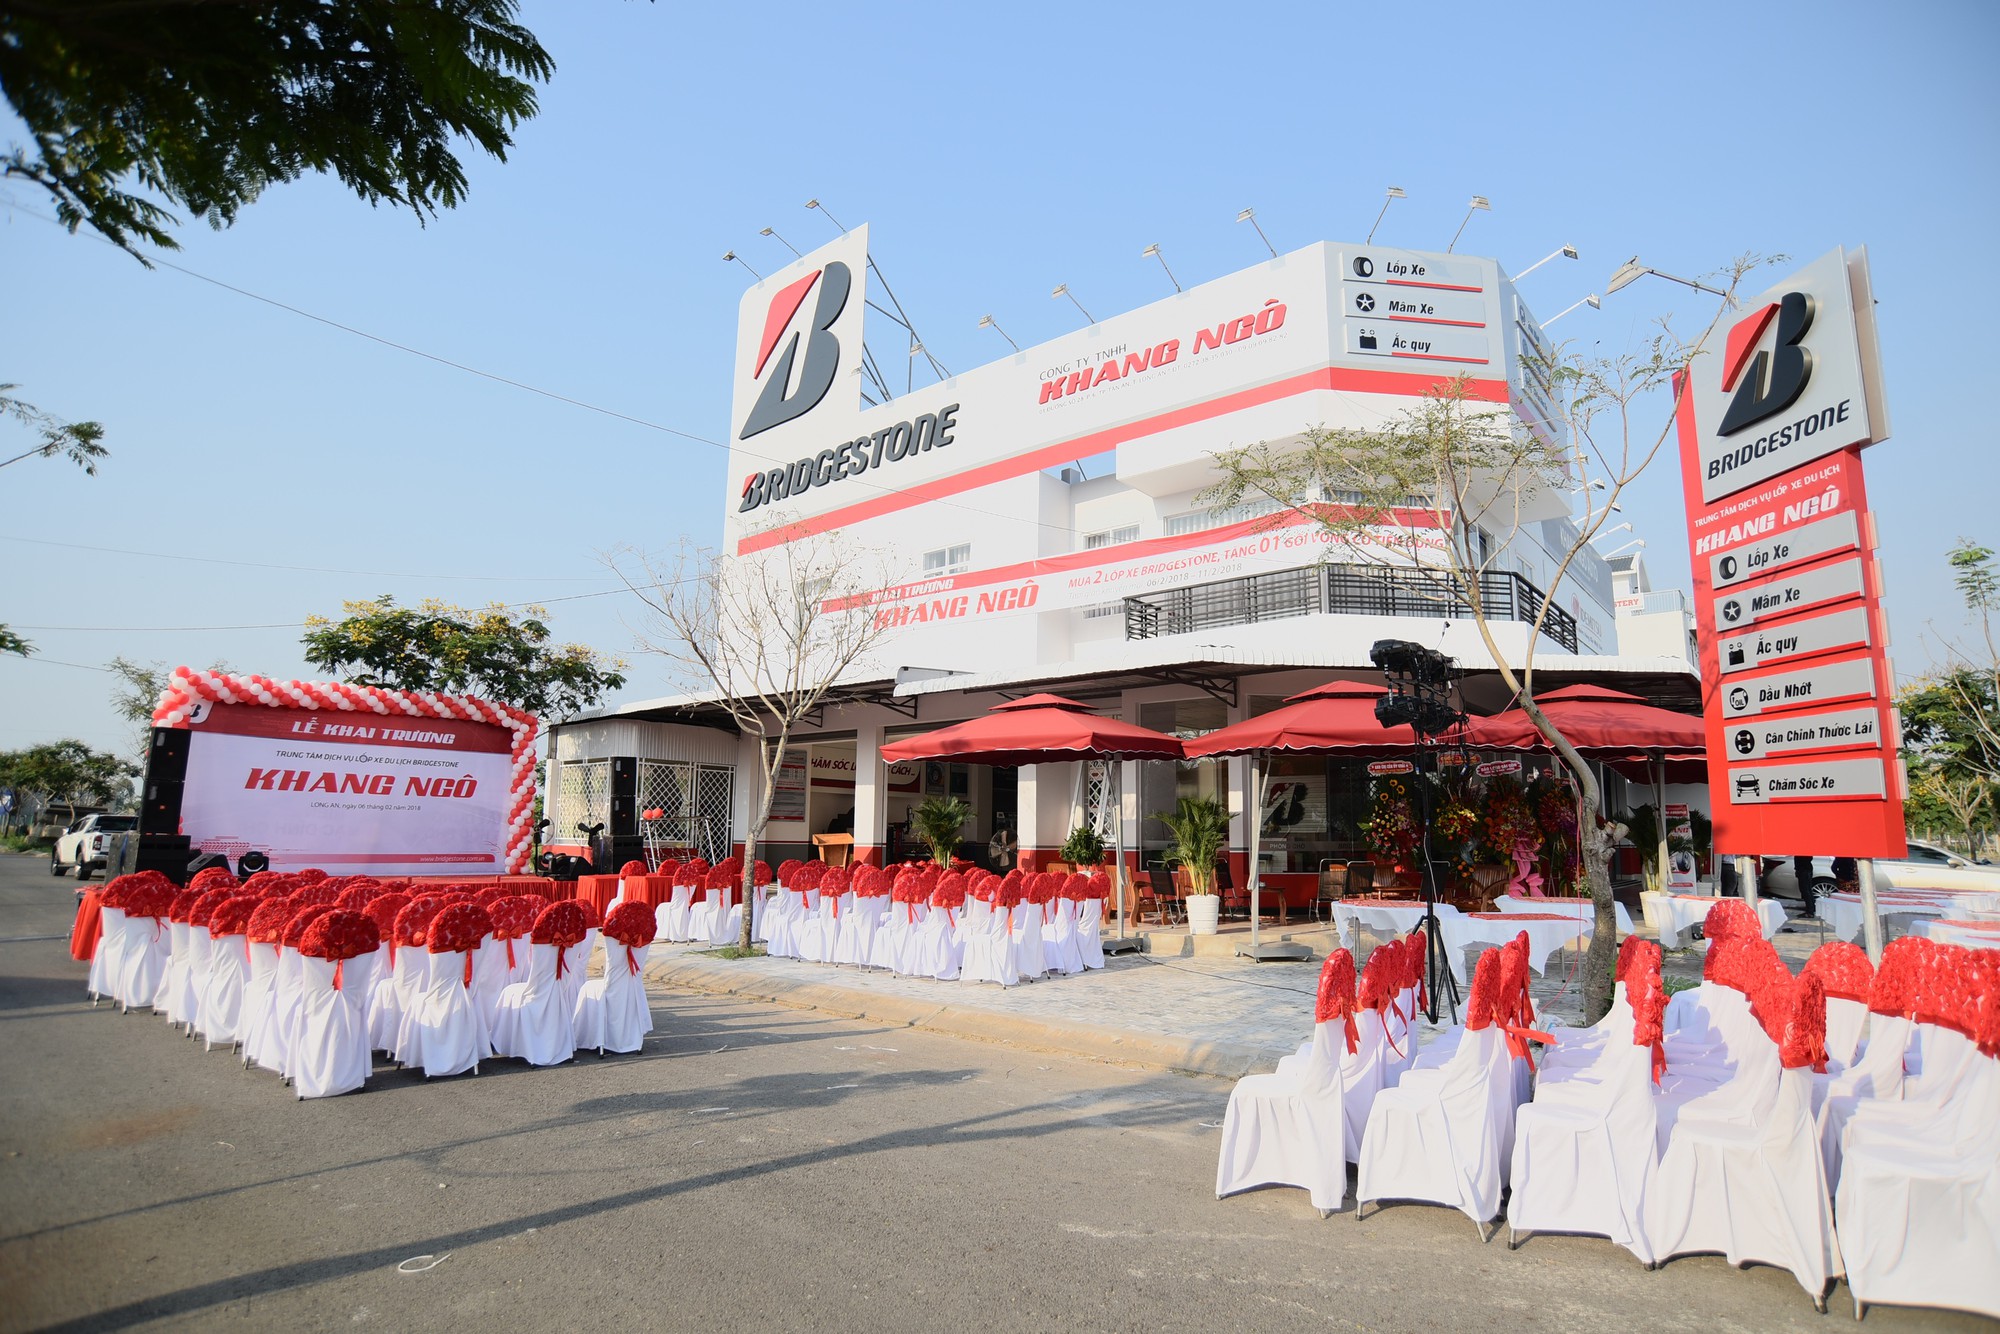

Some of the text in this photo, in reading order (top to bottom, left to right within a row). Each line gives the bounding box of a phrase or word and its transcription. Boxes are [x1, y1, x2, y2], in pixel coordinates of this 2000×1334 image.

[1386, 259, 1426, 276] Lốp Xe
[1388, 300, 1434, 315] Mâm Xe
[1038, 298, 1287, 405] KHANG NGÔ
[1075, 356, 1089, 369] TY
[1096, 343, 1127, 362] TNHH
[1410, 340, 1431, 353] quy
[1707, 399, 1851, 481] BRIDGESTONE
[738, 403, 960, 513] BRIDGESTONE
[1694, 463, 1841, 528] TRUNG TÂM DỊCH VỤ LỐP XE DU LỊCH
[1695, 484, 1841, 556] KHANG NGÔ
[1068, 576, 1091, 588] MUA
[1093, 570, 1103, 584] 2
[1126, 567, 1139, 578] XE
[1259, 535, 1280, 553] 01
[1747, 544, 1789, 568] Lốp Xe
[1198, 562, 1242, 578] 11/2/2018
[871, 588, 902, 602] KHAI
[873, 579, 1039, 631] KHANG NGÔ
[1751, 587, 1801, 612] Mâm Xe
[1776, 636, 1798, 654] quy
[1759, 684, 1781, 702] Dầu
[292, 716, 319, 734] LỄ
[322, 724, 376, 739] KHAI
[1765, 732, 1783, 744] Cân
[1855, 721, 1873, 735] Lái
[276, 750, 304, 759] TRUNG
[395, 758, 412, 766] LỊCH
[412, 759, 460, 768] BRIDGESTONE
[811, 757, 831, 769] HĂM
[832, 759, 850, 770] SÓC
[244, 768, 478, 799] KHANG NGÔ
[1768, 776, 1835, 791] Chăm Sóc Xe
